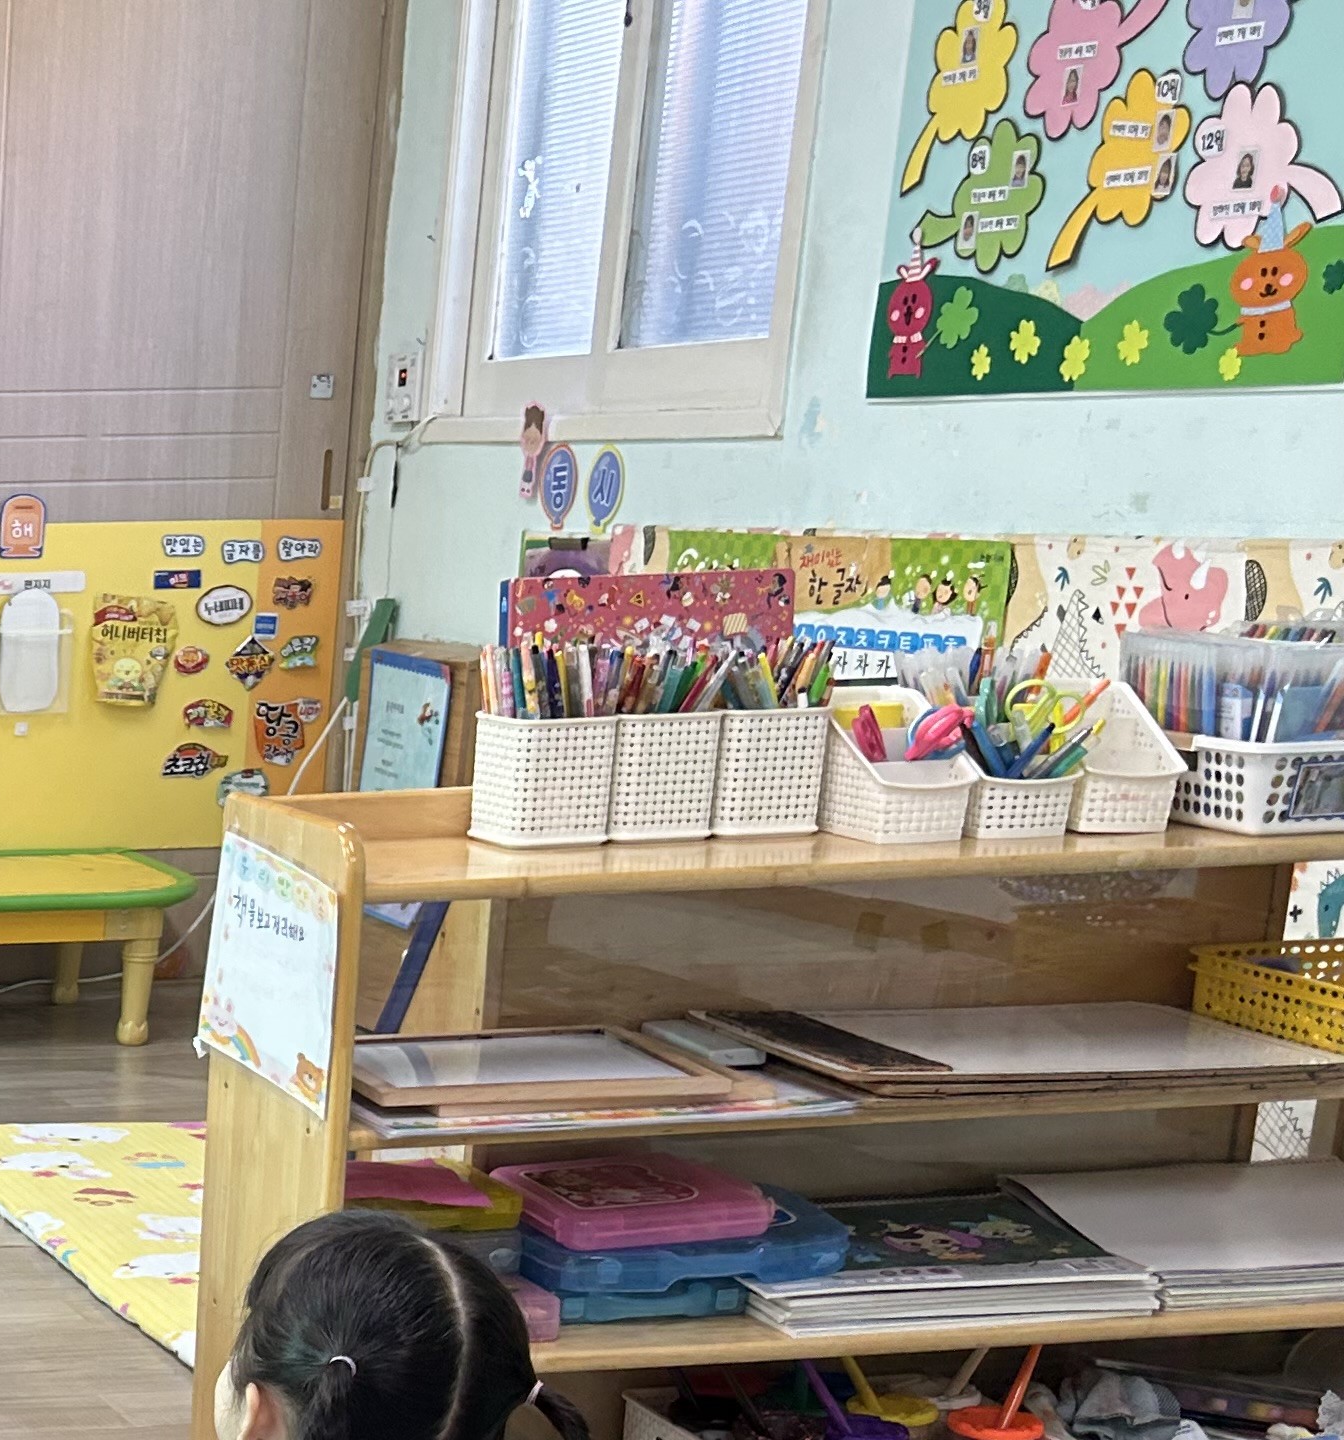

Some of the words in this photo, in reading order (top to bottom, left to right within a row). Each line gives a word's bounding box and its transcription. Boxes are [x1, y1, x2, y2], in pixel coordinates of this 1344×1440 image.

[1157, 79, 1179, 100] 10월
[1202, 129, 1226, 152] 12월
[551, 464, 568, 509] 동
[593, 467, 615, 507] 시
[164, 537, 203, 553] 맛있는
[225, 543, 260, 560] 글자를
[281, 540, 319, 557] 찾아라
[799, 548, 842, 569] 재미있는
[808, 570, 828, 604] 한
[832, 568, 862, 605] 글자
[101, 624, 168, 644] 허니버터칩
[854, 652, 869, 676] 차
[876, 655, 891, 678] 카
[162, 753, 210, 777] 초코칩
